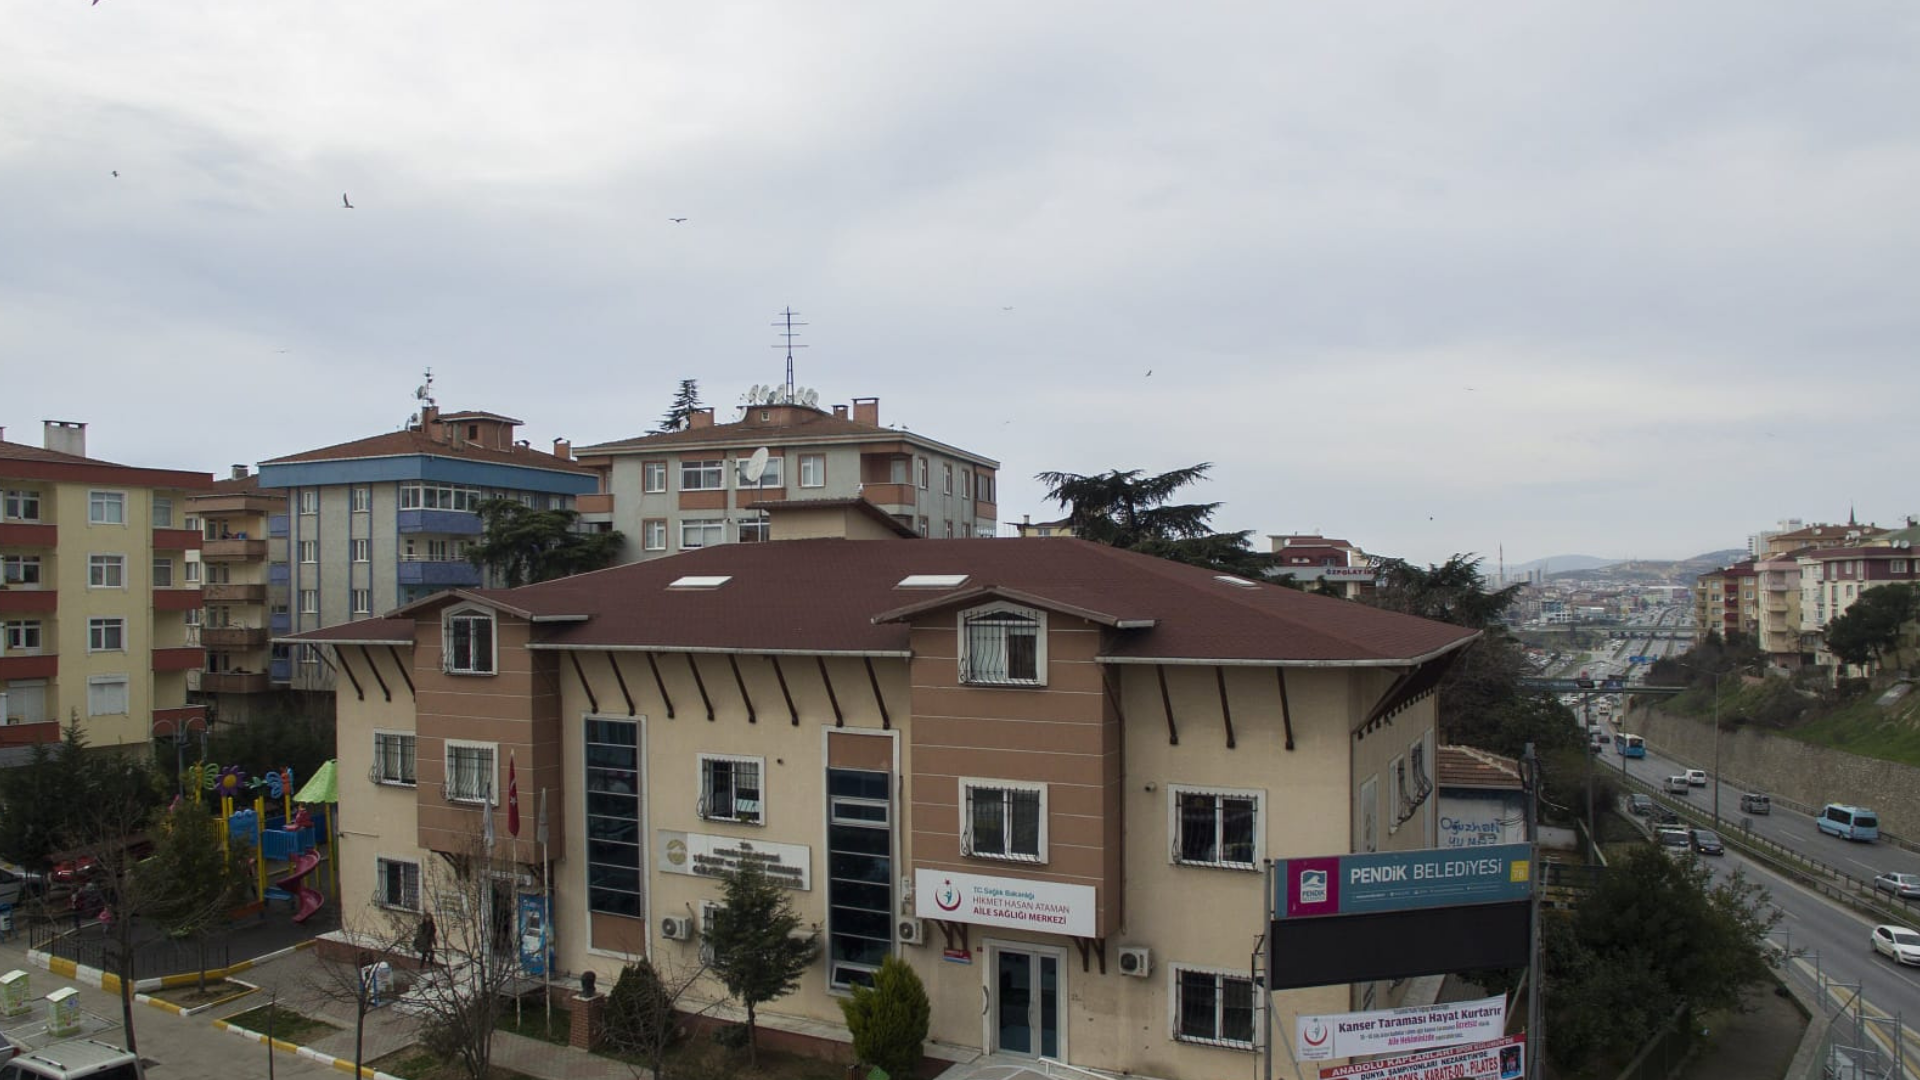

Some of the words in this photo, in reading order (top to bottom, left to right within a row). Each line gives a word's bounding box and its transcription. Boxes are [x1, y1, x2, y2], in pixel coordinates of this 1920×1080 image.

[1413, 858, 1502, 880] BELEDİYESİ
[972, 895, 1002, 907] HİKMET
[1004, 898, 1034, 910] HASAN
[1035, 902, 1070, 914] ATAMAN
[973, 906, 991, 916] AİLE
[993, 907, 1027, 920] SAĞLIĞI
[1028, 913, 1067, 925] MERKEZİ
[1338, 1020, 1376, 1033] Kanser
[1377, 1015, 1427, 1029] Taraması
[1428, 1010, 1458, 1024] Hayat
[1461, 1006, 1502, 1019] Kurtarır
[1331, 1060, 1384, 1077] ANADOLU
